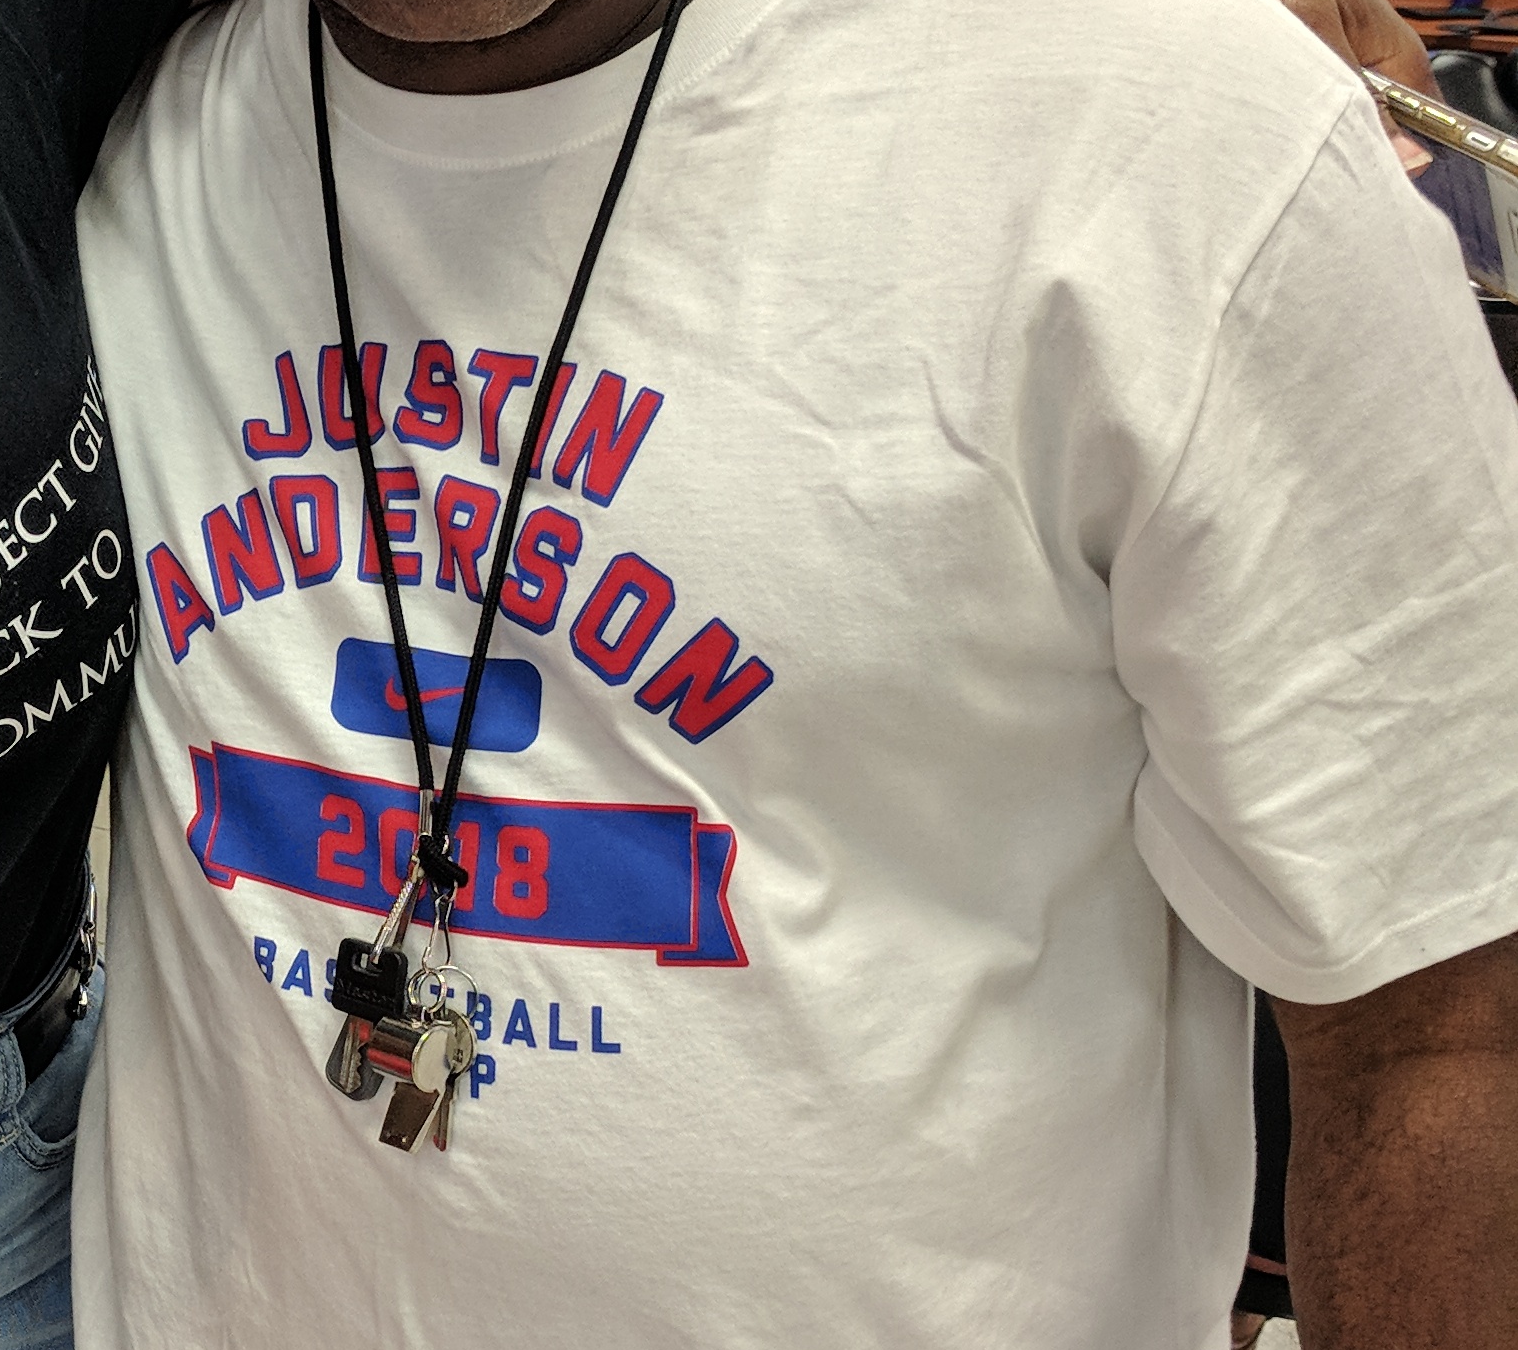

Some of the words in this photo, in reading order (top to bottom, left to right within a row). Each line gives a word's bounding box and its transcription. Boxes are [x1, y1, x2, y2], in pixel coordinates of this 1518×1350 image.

[243, 339, 664, 507] JUSTIN
[60, 528, 123, 610] TO
[146, 466, 774, 745] ANDERSON
[317, 793, 550, 920] 2018
